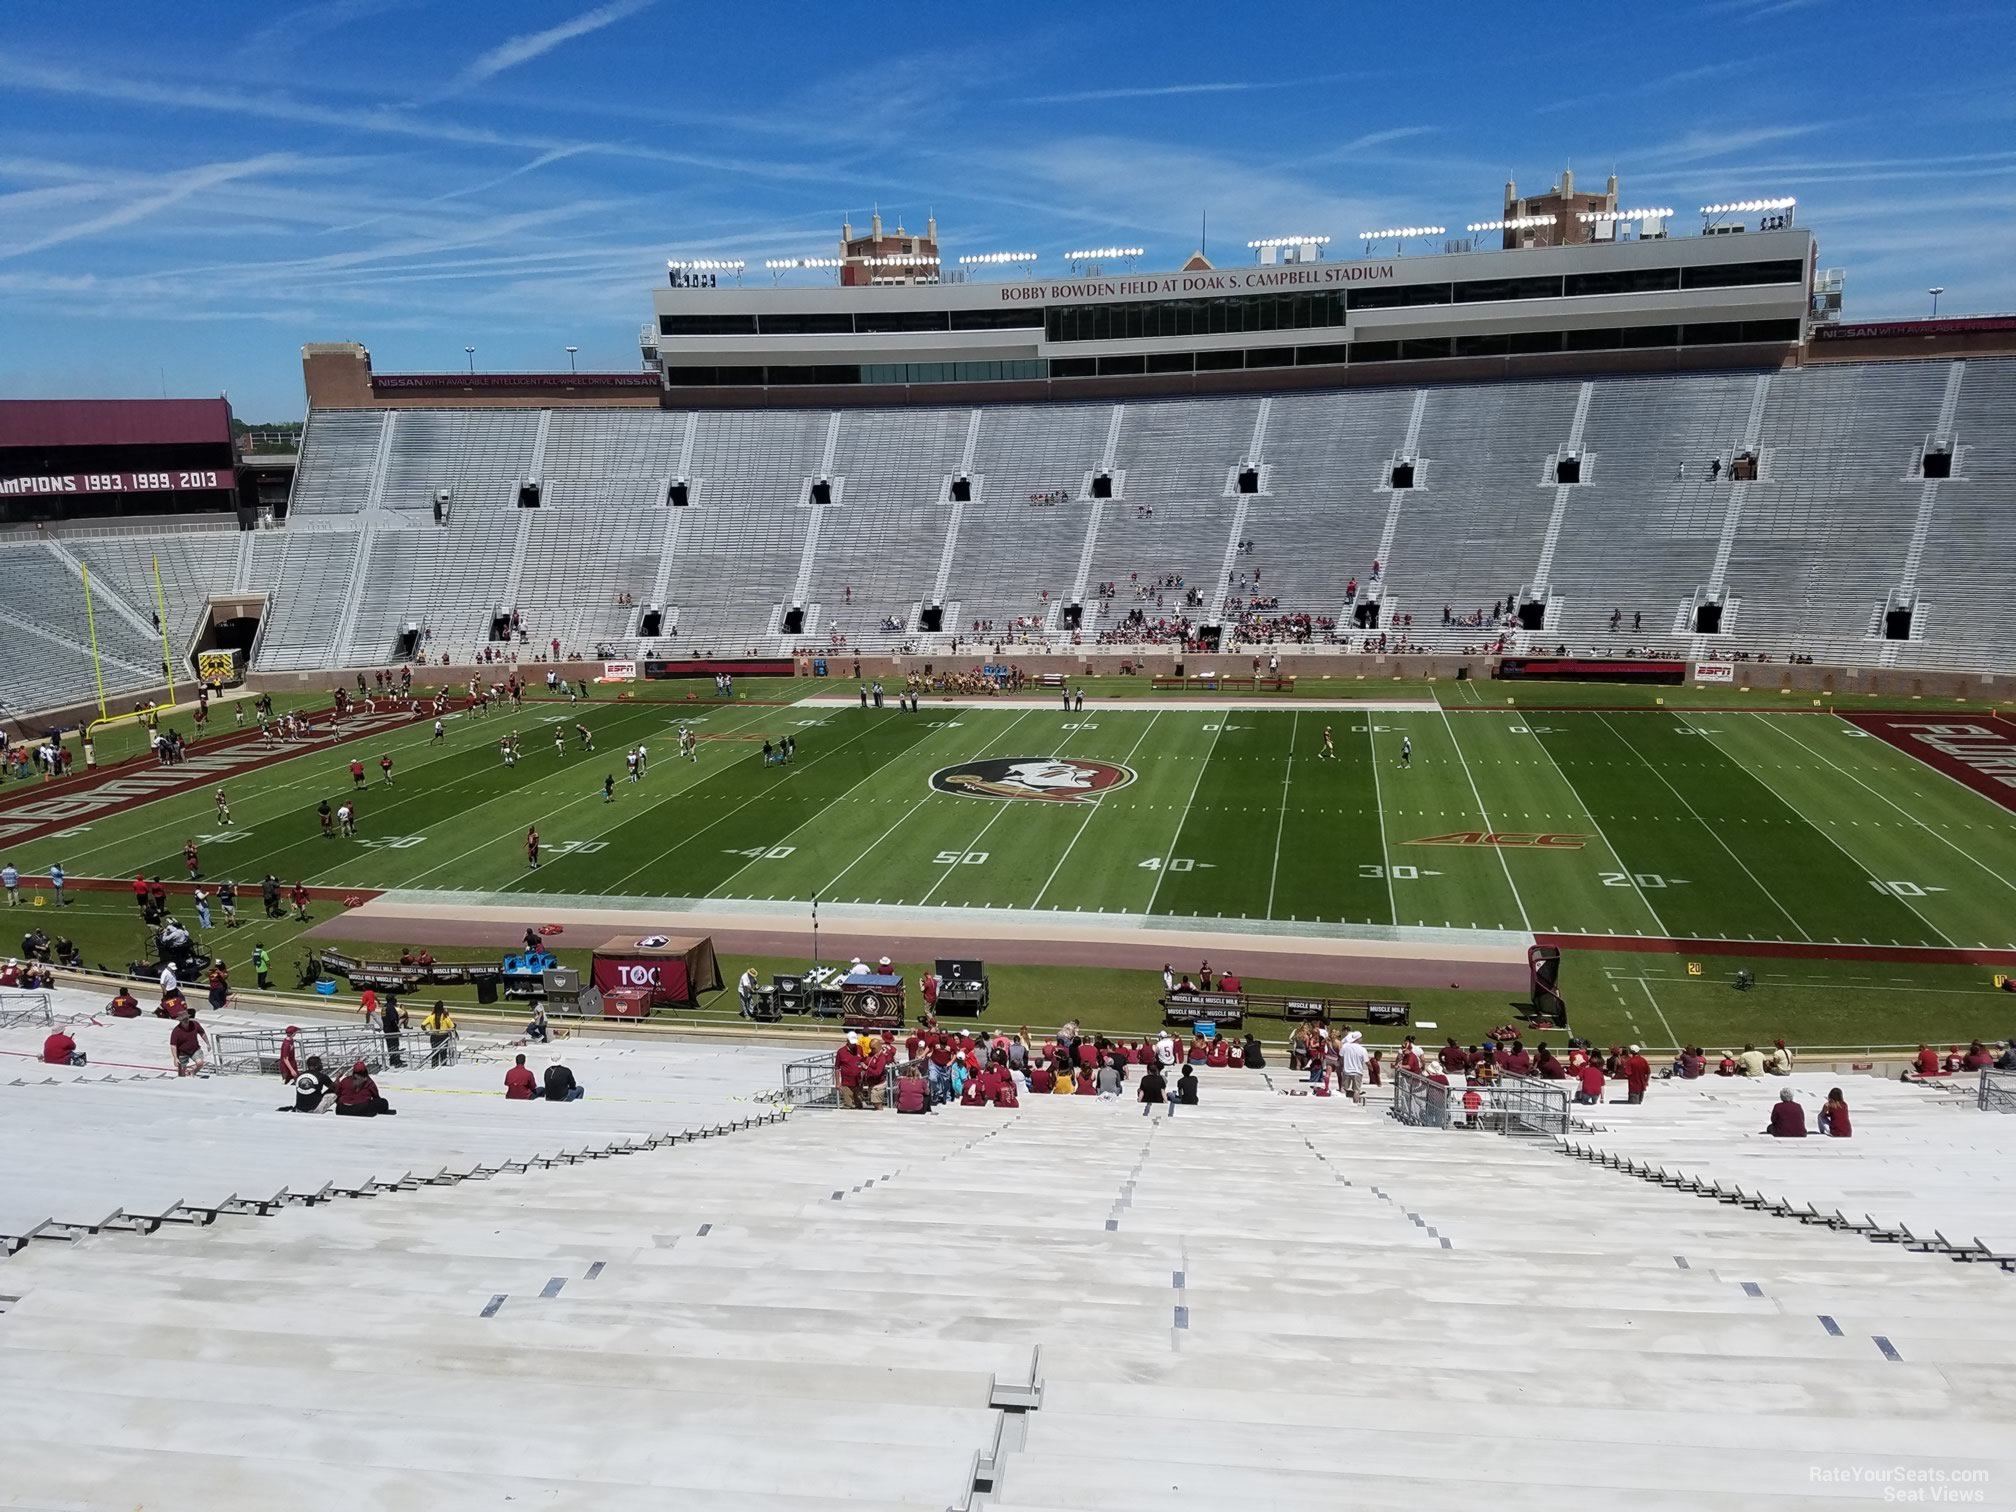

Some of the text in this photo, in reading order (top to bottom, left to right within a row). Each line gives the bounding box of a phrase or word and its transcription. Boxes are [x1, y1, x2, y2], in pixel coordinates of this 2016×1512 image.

[1001, 265, 1393, 301] BOBBY BOWDEN FIELD AT DOAK S. CAMPBELL STADIUM
[378, 379, 422, 387] NISSAN
[84, 474, 128, 492] 1993,
[132, 472, 175, 490] 1999,
[179, 472, 217, 488] 2013
[607, 664, 633, 673] ESPN
[1697, 666, 1731, 676] ESPN
[363, 836, 427, 848] 20
[547, 840, 611, 854] 30
[1402, 831, 1598, 850] ACC
[737, 846, 797, 859] 40
[932, 851, 990, 865] 50
[1137, 857, 1196, 872] 40
[1358, 864, 1419, 880] 30
[1598, 872, 1668, 888] 20
[1868, 880, 1928, 896] 10
[1192, 996, 1204, 1004] MILK
[1288, 1001, 1323, 1010] MUSCLE MILK
[1167, 1008, 1187, 1016] MUSCLE
[1207, 1009, 1240, 1018] MUSCLE MILK
[1369, 1005, 1405, 1014] MUSCLE MILK
